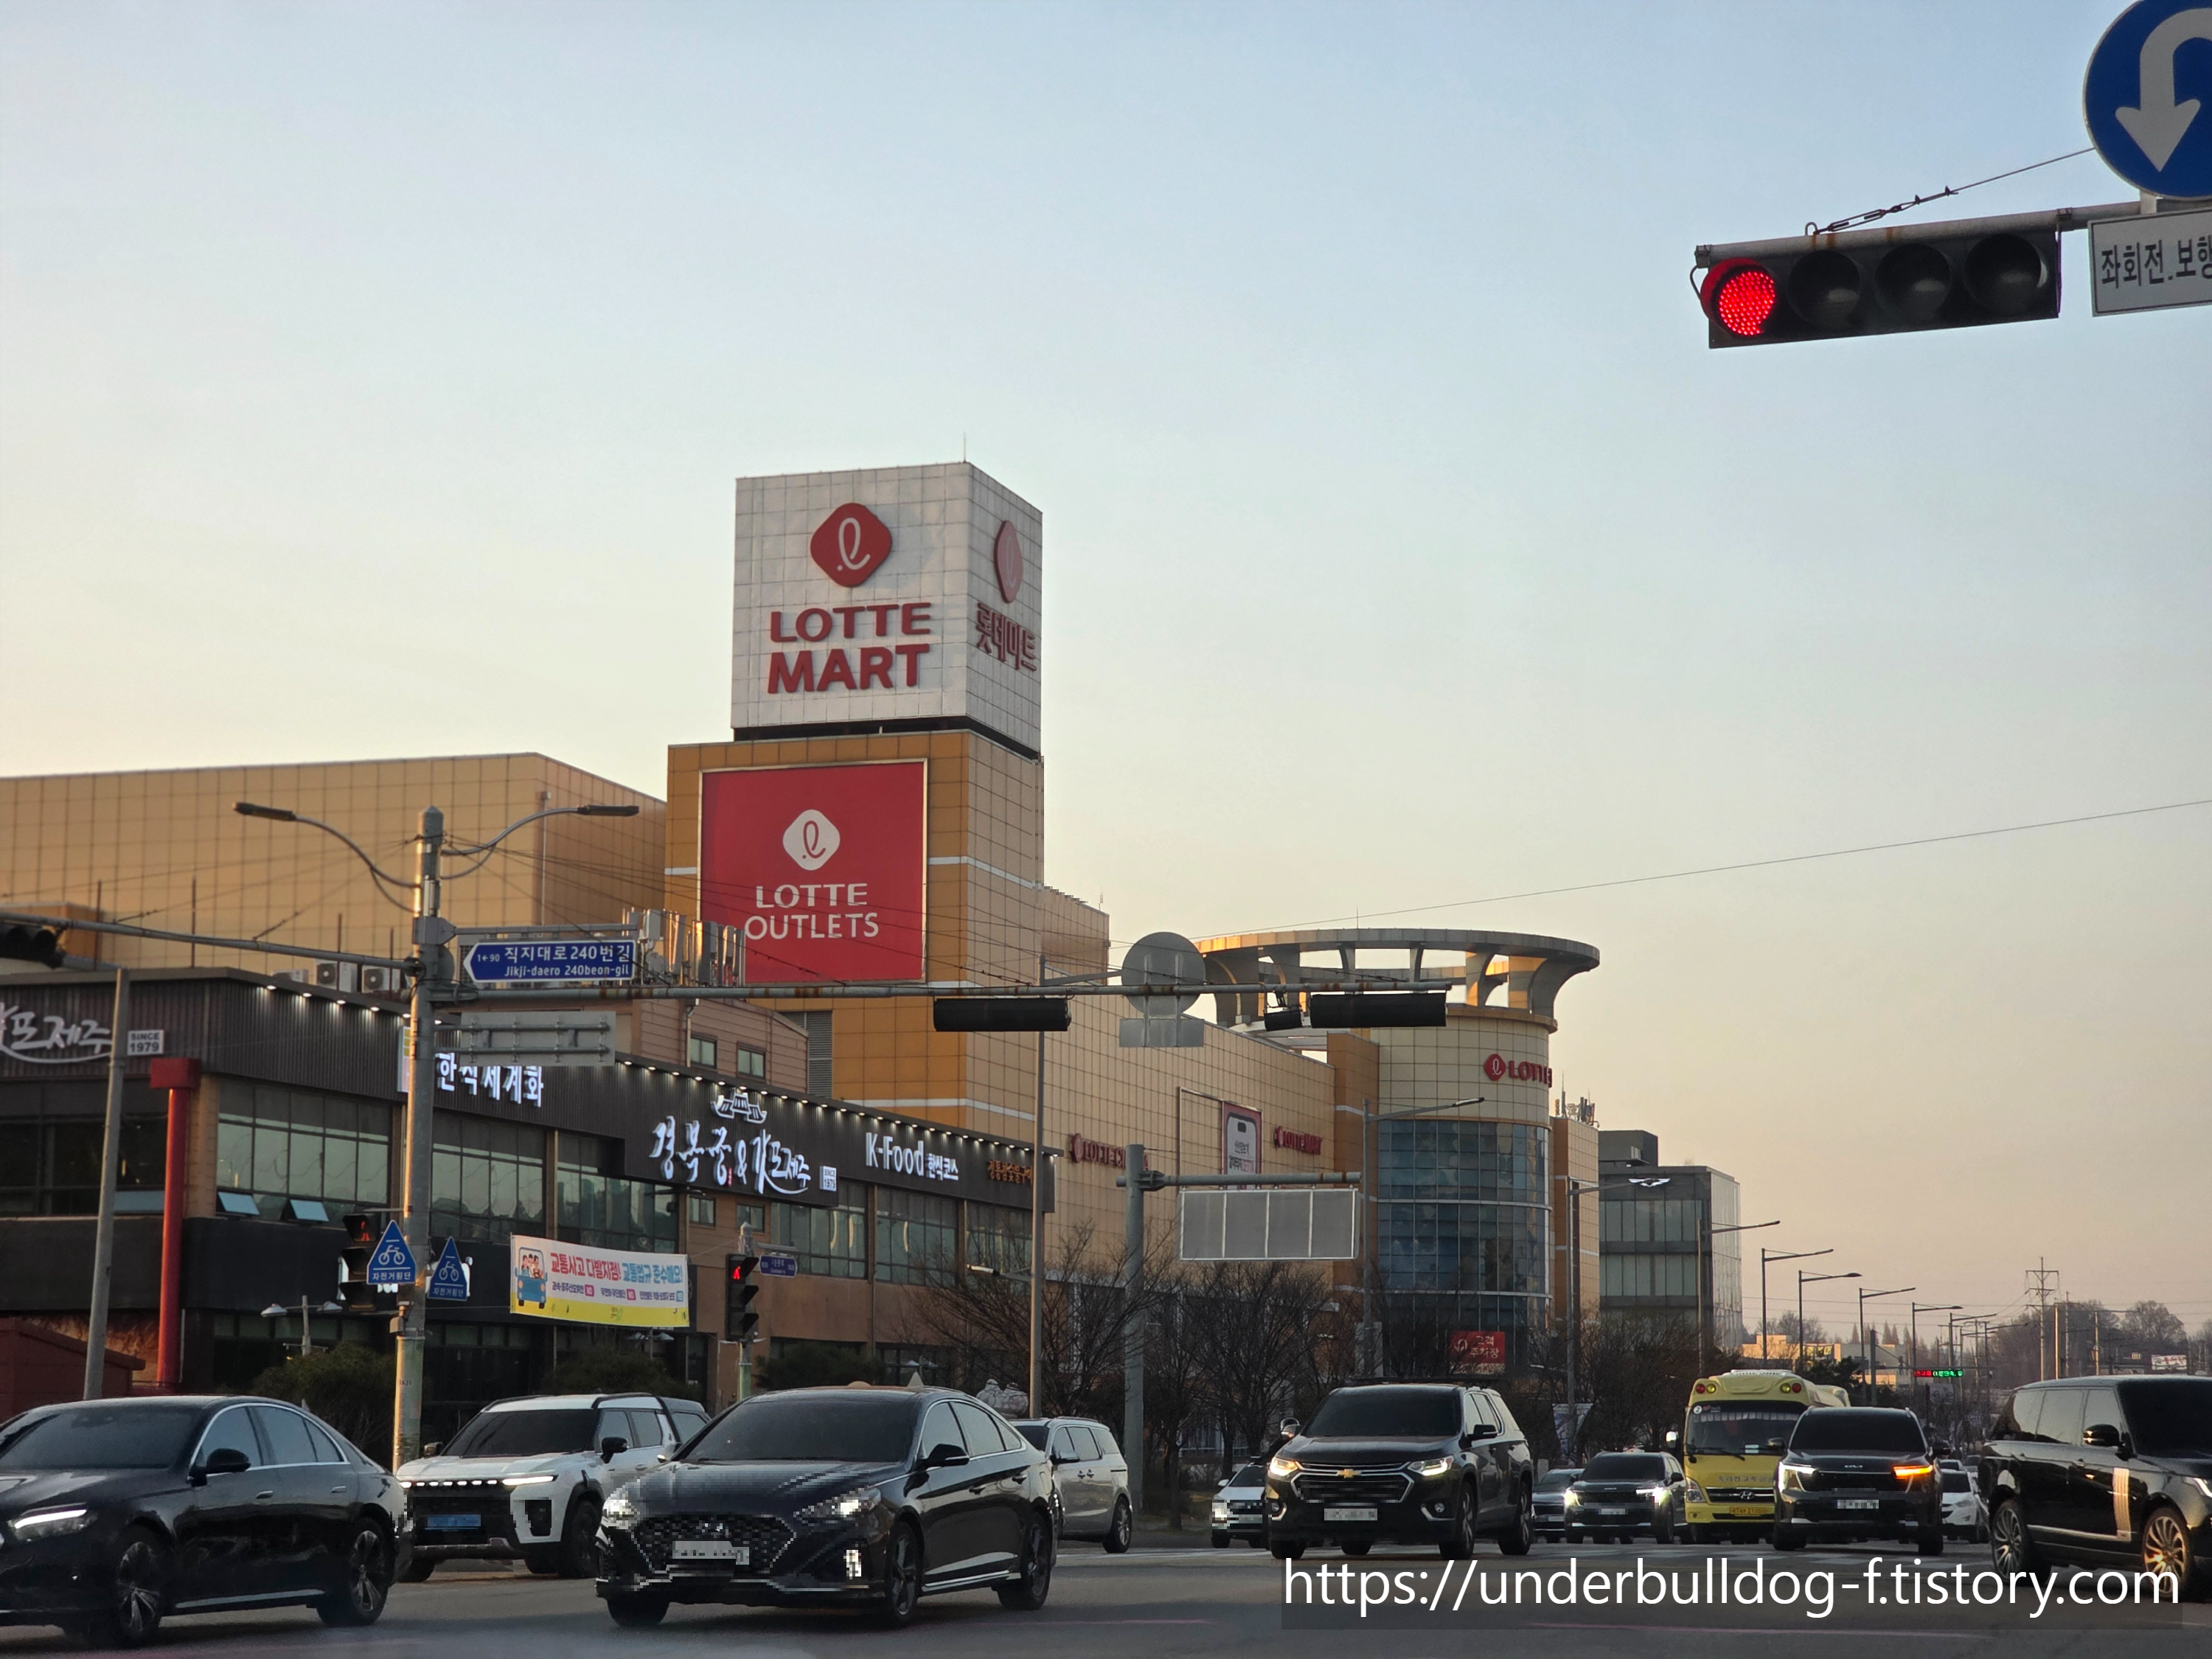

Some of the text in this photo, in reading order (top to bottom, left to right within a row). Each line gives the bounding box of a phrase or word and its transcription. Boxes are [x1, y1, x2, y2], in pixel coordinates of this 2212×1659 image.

[770, 602, 931, 642] LOTTE
[975, 602, 1037, 672] 롯데마트
[767, 643, 930, 694] MART
[756, 883, 868, 908] LOTTE
[745, 912, 879, 940] OUTLETS
[504, 964, 629, 978] Jikji-daero 240beon-gil
[130, 1041, 159, 1053] 1979
[866, 1132, 959, 1181] K-Food 한식코스
[372, 1271, 411, 1281] 자전거횡단
[550, 1252, 585, 1276] 교통사고
[585, 1258, 622, 1281] 다발지점!
[622, 1262, 652, 1284] 교통법규
[433, 1287, 464, 1298] 자전거횡단
